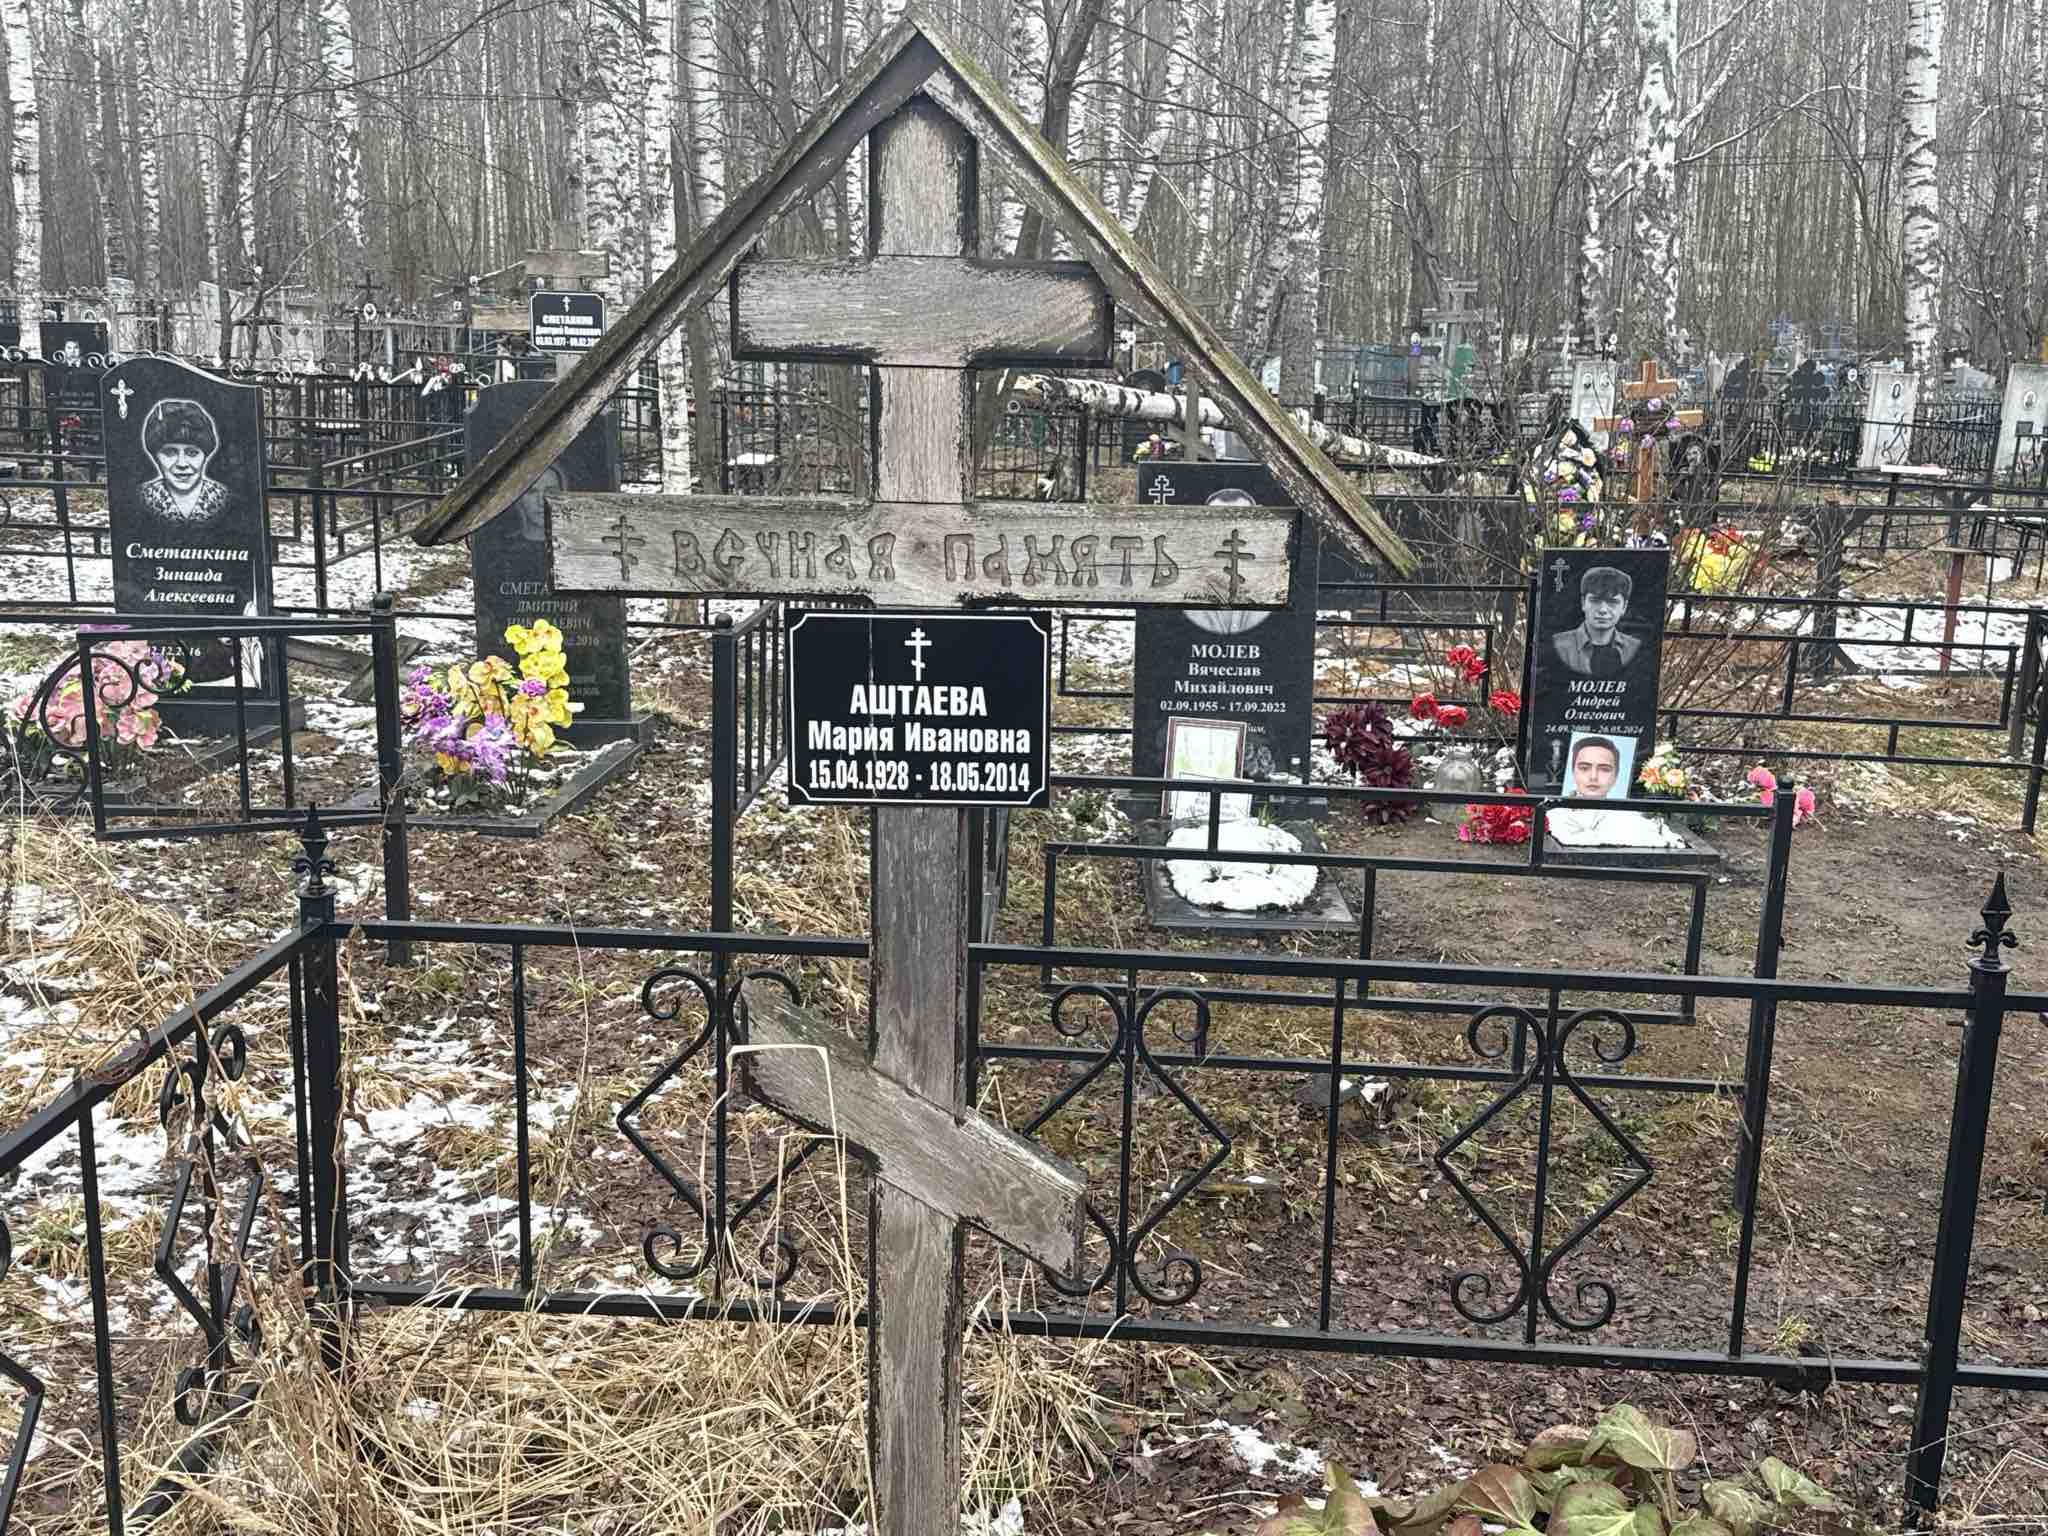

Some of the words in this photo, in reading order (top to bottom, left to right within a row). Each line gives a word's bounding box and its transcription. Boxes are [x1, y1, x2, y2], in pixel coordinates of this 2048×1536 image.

[126, 543, 249, 561] Сметанкина
[943, 533, 1180, 588] ПАМЯТЬ
[154, 566, 223, 582] Зинаида
[143, 588, 236, 604] Алексеевна
[499, 581, 550, 595] СМЕТА
[1191, 644, 1261, 659] МОЛЕВ
[1187, 662, 1261, 677] Вячеслав
[1173, 679, 1274, 695] Михайлович
[1567, 680, 1627, 694] МОЛЕВ
[849, 684, 988, 717] АШТАЕВА
[1160, 700, 1218, 712] 02.09.1955
[1229, 701, 1287, 713] 17.09.2022
[1571, 695, 1621, 709] Андрей
[1564, 708, 1626, 721] Олегович
[807, 719, 894, 756] Мария
[904, 721, 1031, 754] Ивановна
[808, 759, 910, 791] 15.04.1928
[929, 761, 1030, 792] 18.05.2014
